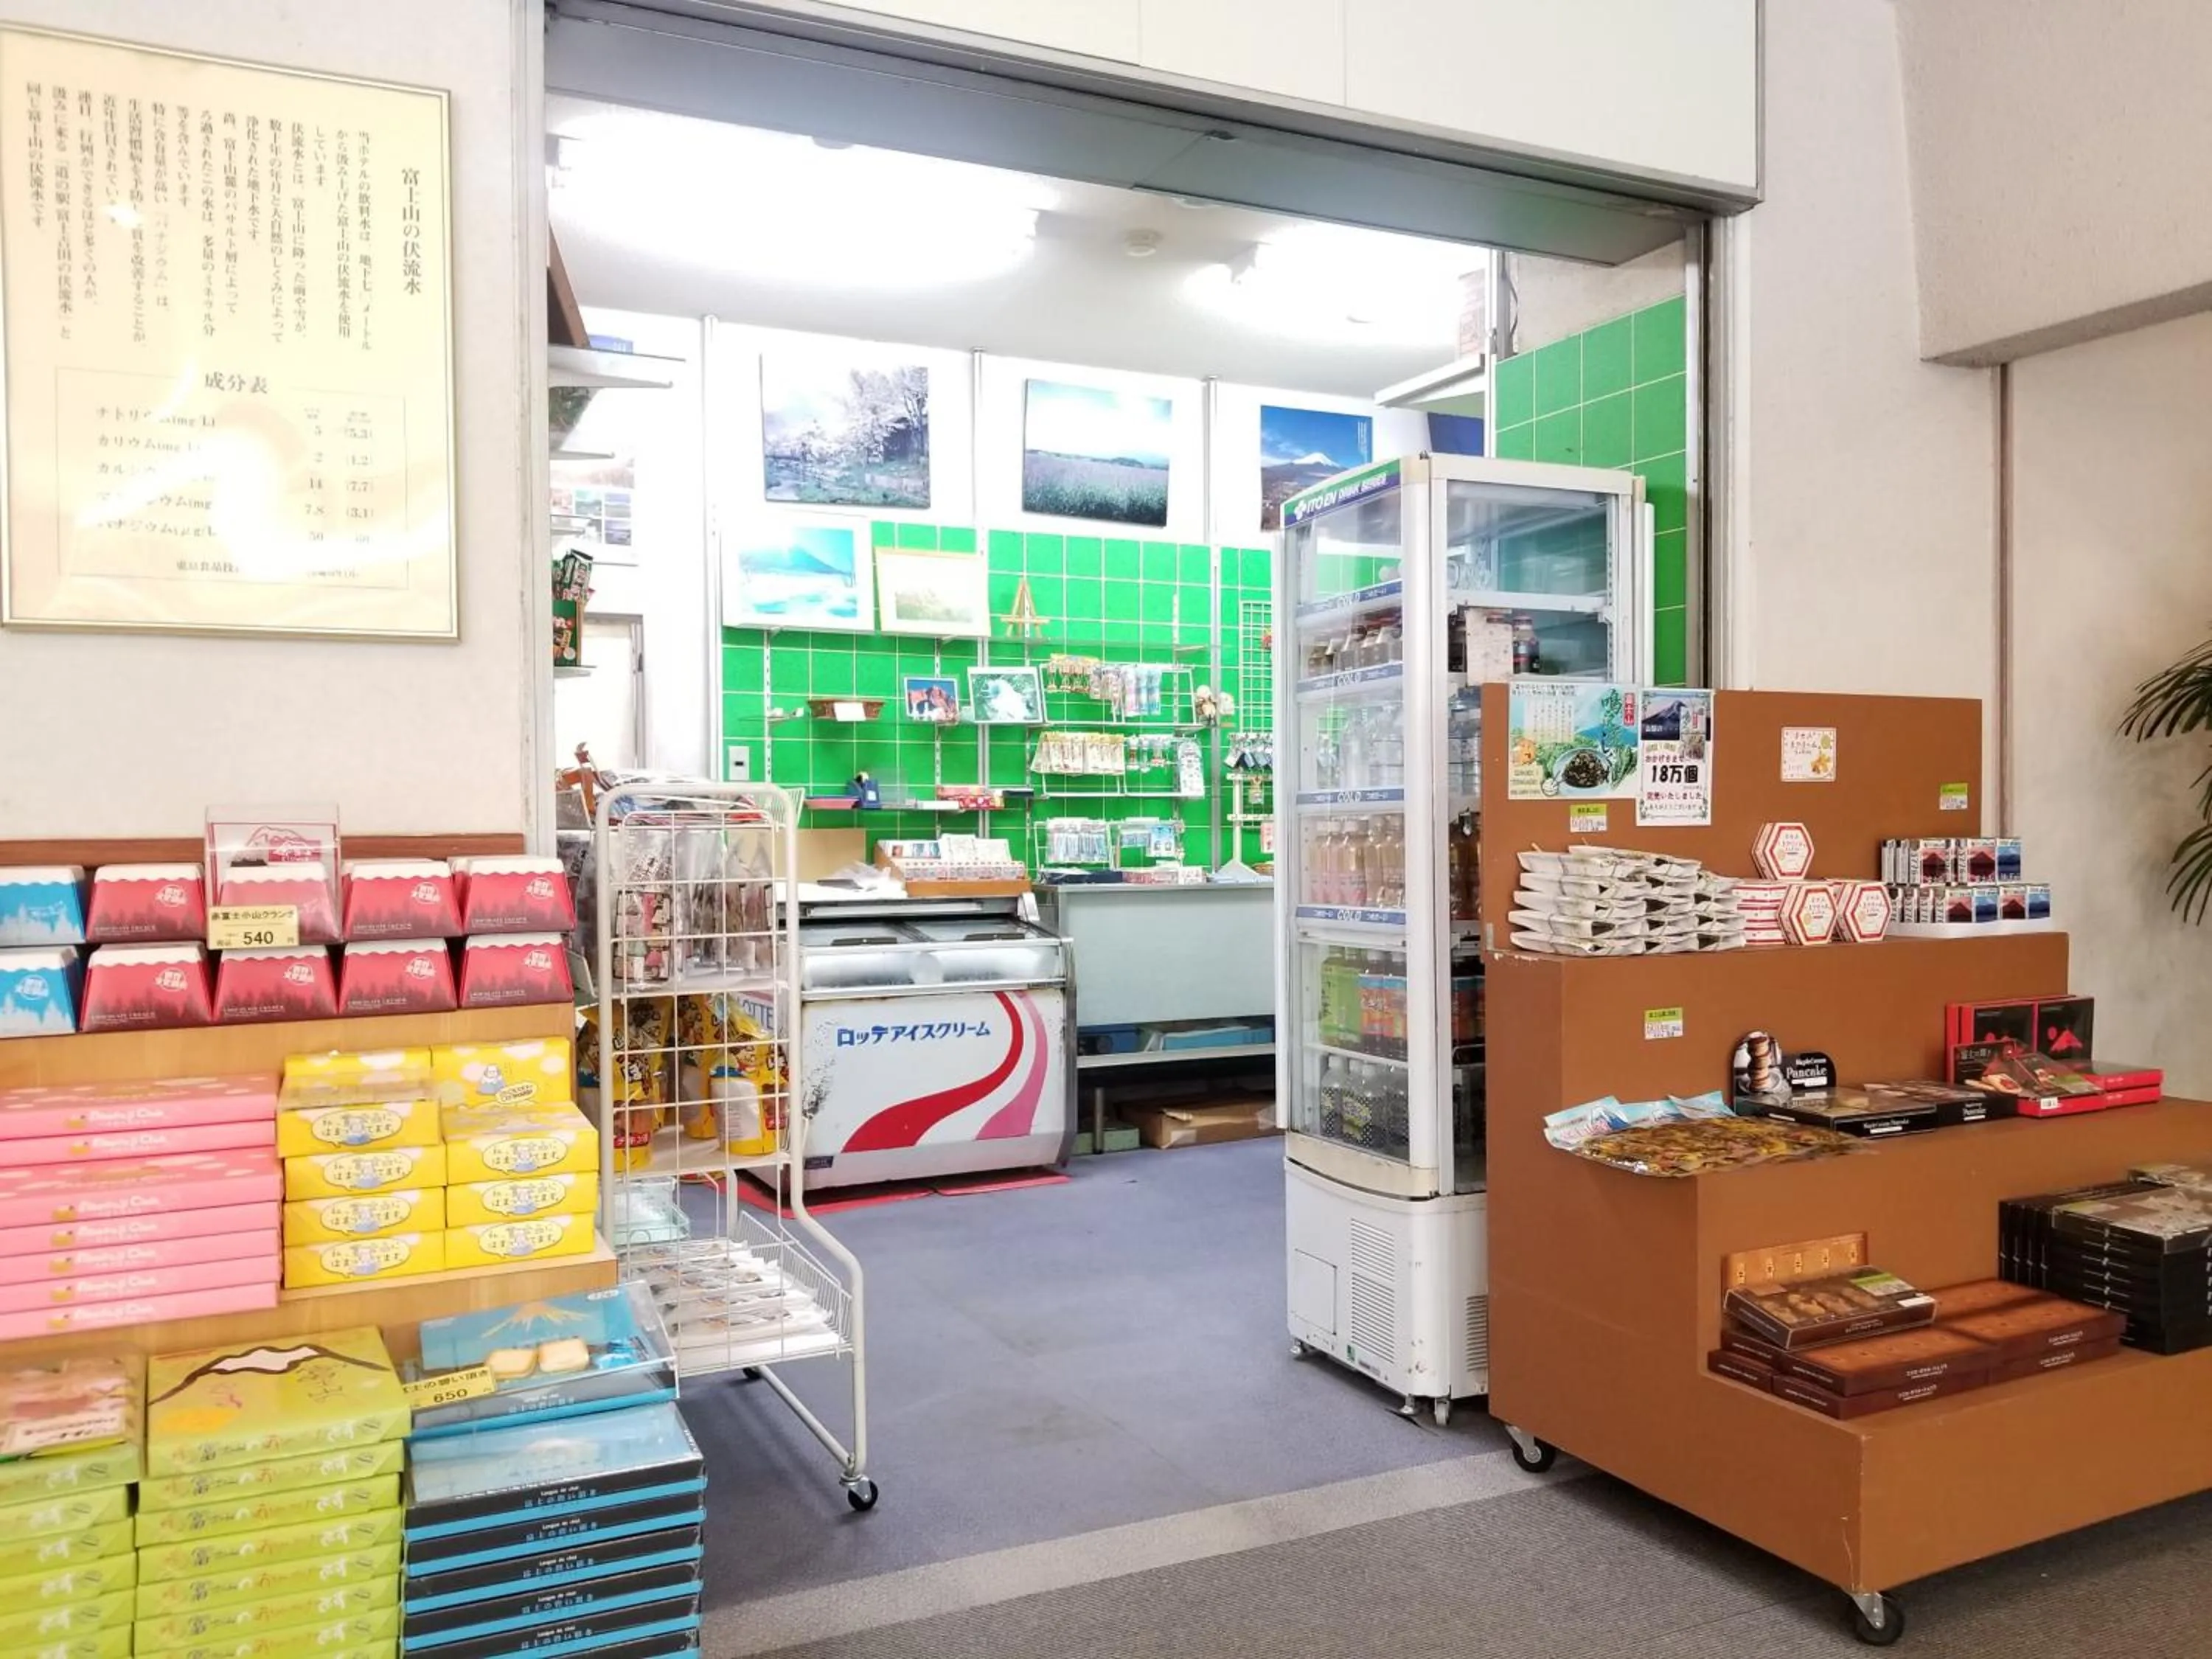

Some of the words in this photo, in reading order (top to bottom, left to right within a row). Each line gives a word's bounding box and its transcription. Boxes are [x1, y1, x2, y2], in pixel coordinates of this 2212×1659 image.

[403, 168, 422, 295] 富士山の伏流水
[204, 372, 268, 394] 成分表
[1307, 495, 1324, 514] ITO
[1324, 490, 1337, 508] EN
[1652, 765, 1698, 783] 18万個
[1337, 791, 1362, 803] COLD
[1337, 909, 1362, 921] COLD
[243, 931, 274, 945] 540
[737, 996, 773, 1031] OTTE
[837, 1021, 991, 1047] ロッテアイスクリーム
[1787, 1064, 1828, 1079] Pancake
[434, 1389, 468, 1403] 650
